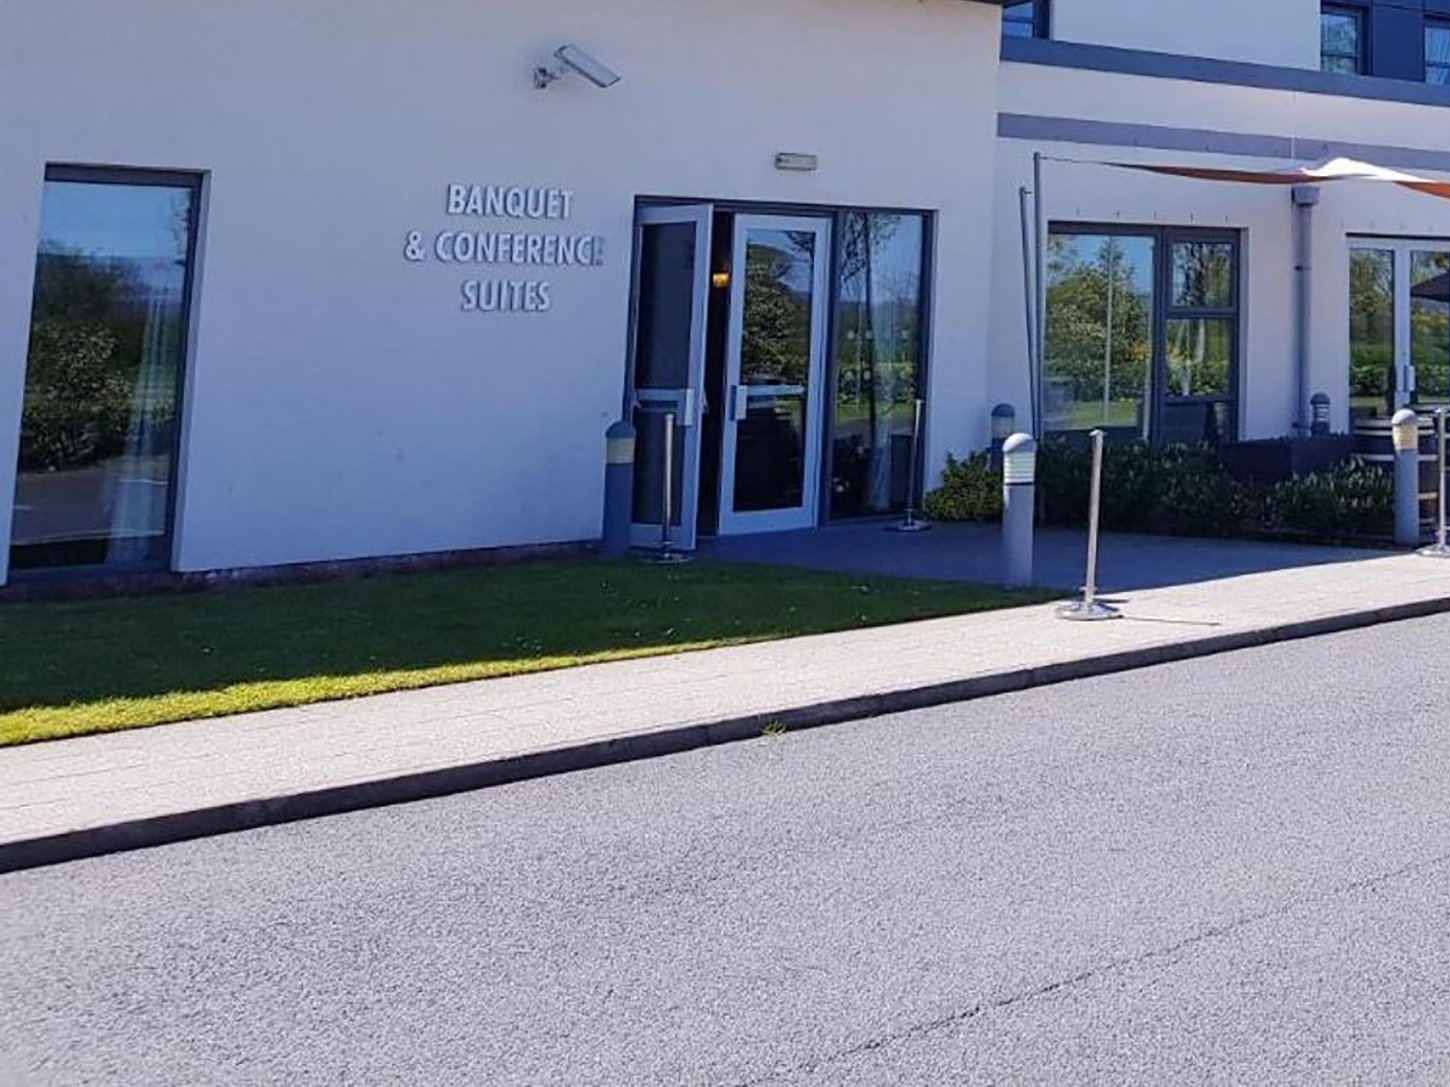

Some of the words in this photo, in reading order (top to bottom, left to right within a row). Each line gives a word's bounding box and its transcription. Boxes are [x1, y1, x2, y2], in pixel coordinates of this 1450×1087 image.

[447, 184, 573, 219] BANQUET
[404, 230, 426, 262] &
[435, 232, 605, 266] CONFERENCE
[461, 279, 551, 312] SUITES
